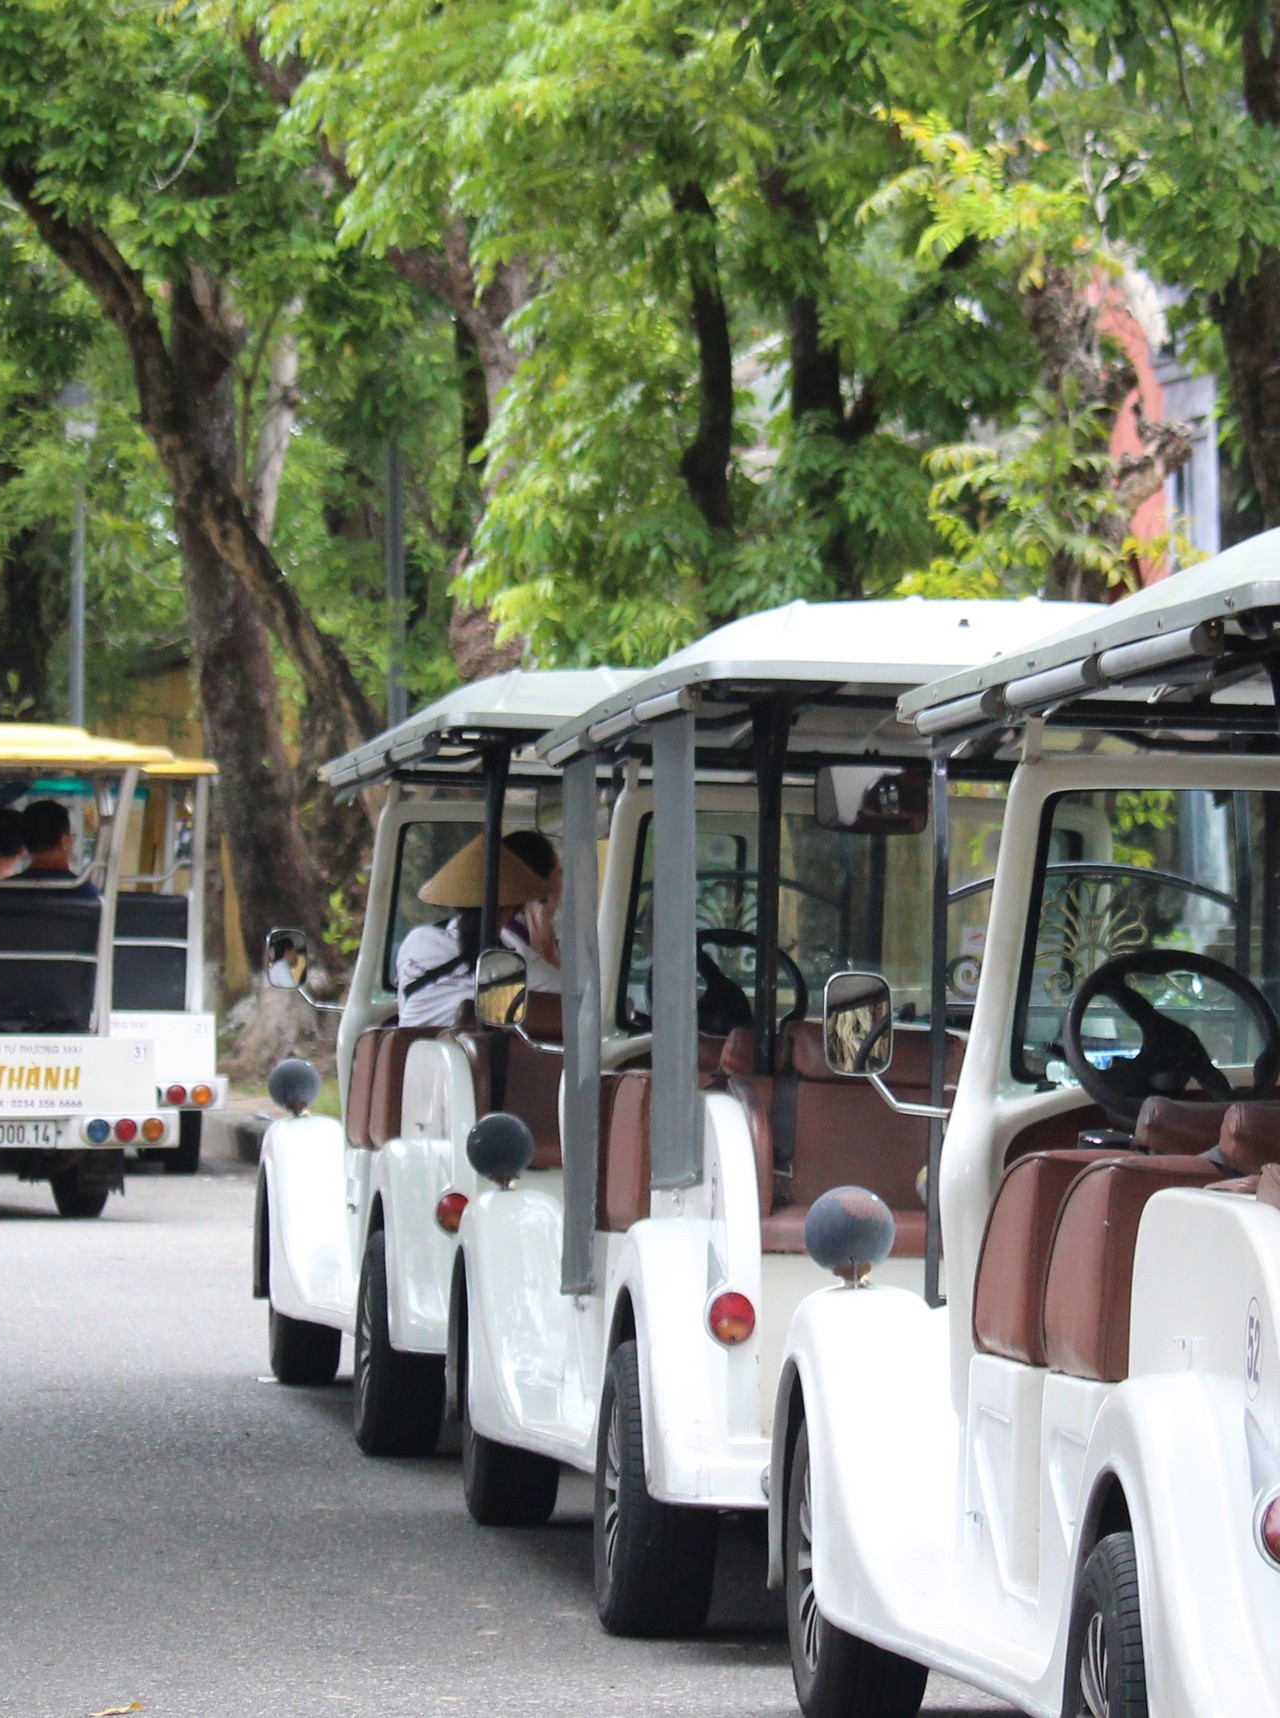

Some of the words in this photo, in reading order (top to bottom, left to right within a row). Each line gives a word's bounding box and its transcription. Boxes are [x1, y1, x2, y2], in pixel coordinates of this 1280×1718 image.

[133, 1046, 148, 1059] 31
[11, 1099, 35, 1109] 0234
[1247, 1315, 1261, 1385] 52
